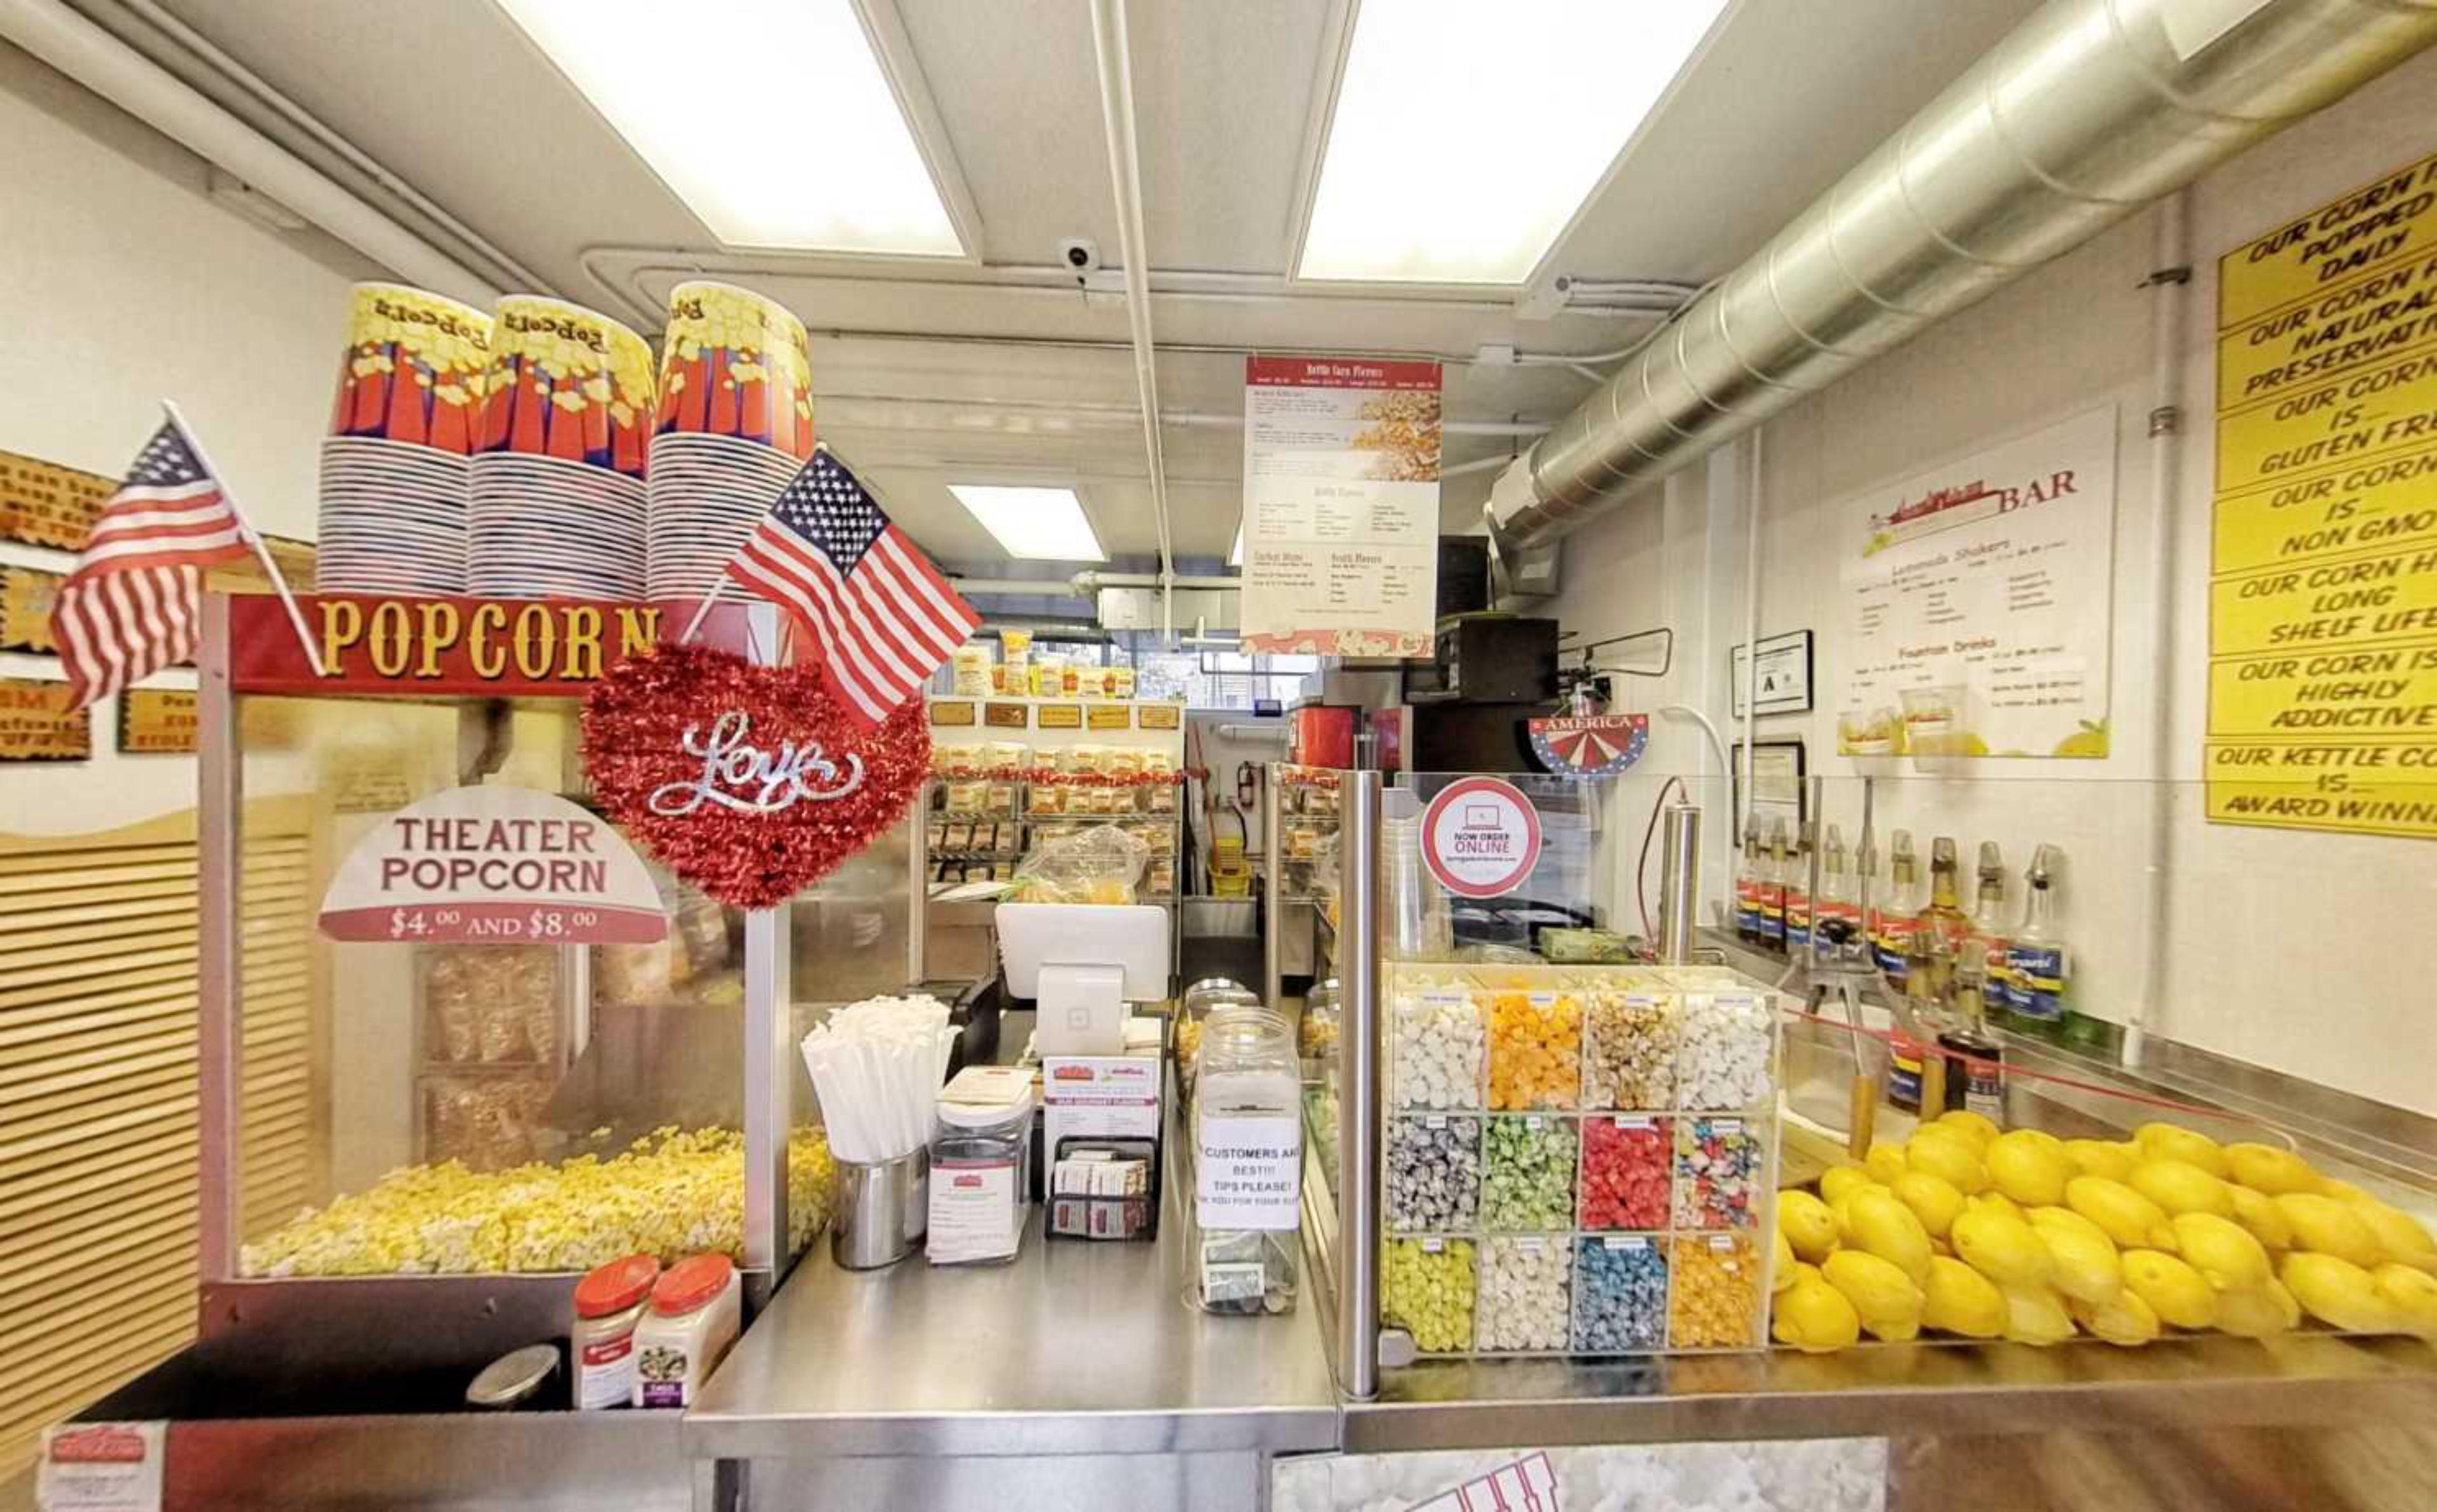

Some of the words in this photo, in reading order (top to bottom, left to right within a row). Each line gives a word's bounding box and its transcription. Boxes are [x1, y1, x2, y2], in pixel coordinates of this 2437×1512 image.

[2250, 221, 2311, 263] OUR
[2319, 172, 2415, 230] CORN
[2300, 192, 2434, 264] POPPED
[2319, 227, 2412, 282] DAILY
[2250, 308, 2311, 345] OUR
[2319, 267, 2415, 319] CORN
[374, 298, 490, 352] Popcorn
[504, 312, 610, 355] Popcorn
[2275, 388, 2338, 421] OUR
[2348, 357, 2437, 398] CORN
[2330, 404, 2365, 431] IS
[2259, 429, 2374, 475] GLUTEN
[1999, 470, 2078, 514] BAR
[2271, 478, 2336, 509] OUR
[2342, 455, 2437, 493] CORN
[2324, 498, 2360, 523] IS
[2280, 527, 2352, 556] NON
[2356, 509, 2437, 541] GMO
[2239, 573, 2301, 598] OUR
[2307, 558, 2403, 589] CORN
[2311, 585, 2398, 614] LONG
[318, 600, 661, 680] POPCORN
[2269, 615, 2365, 644] SHELF
[2372, 607, 2437, 634] LIFE
[1764, 676, 1774, 692] A
[2238, 660, 2299, 681] OUR
[2306, 652, 2401, 677] CORN
[2409, 650, 2437, 669] IS
[2295, 680, 2410, 702] HIGHLY
[1545, 716, 1632, 731] AMERICA
[2270, 705, 2437, 727] ADDICTIVE
[649, 708, 866, 816] Love
[2216, 747, 2275, 766] OUR
[2282, 747, 2389, 767] KETTLE
[2225, 796, 2331, 817] AWARD
[393, 818, 595, 853] THEATER
[1455, 841, 1510, 853] ONLINE
[382, 857, 607, 894] POPCORN
[466, 917, 521, 935] AND
[1205, 1147, 1278, 1159] CUSTOMERS
[1214, 1180, 1239, 1192] TIPS
